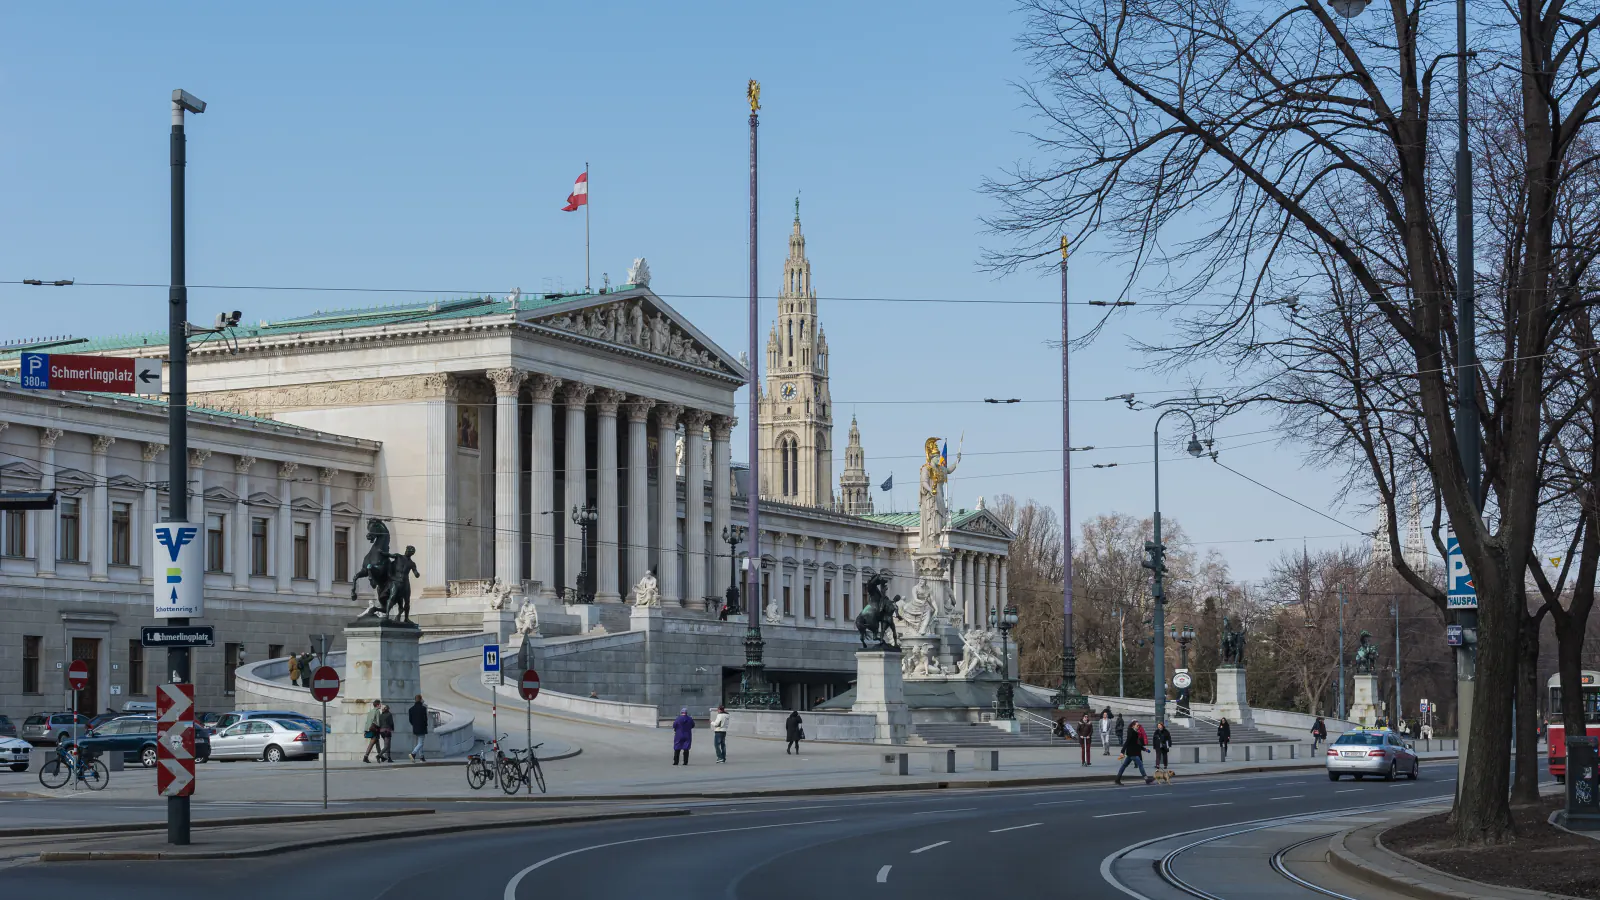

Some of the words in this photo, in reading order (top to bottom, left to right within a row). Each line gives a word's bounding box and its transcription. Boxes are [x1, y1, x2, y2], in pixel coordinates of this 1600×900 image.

[30, 360, 42, 374] P
[51, 365, 133, 384] Schmerlingplatz
[24, 376, 40, 387] 380
[154, 633, 209, 642] chmerlingplatz
